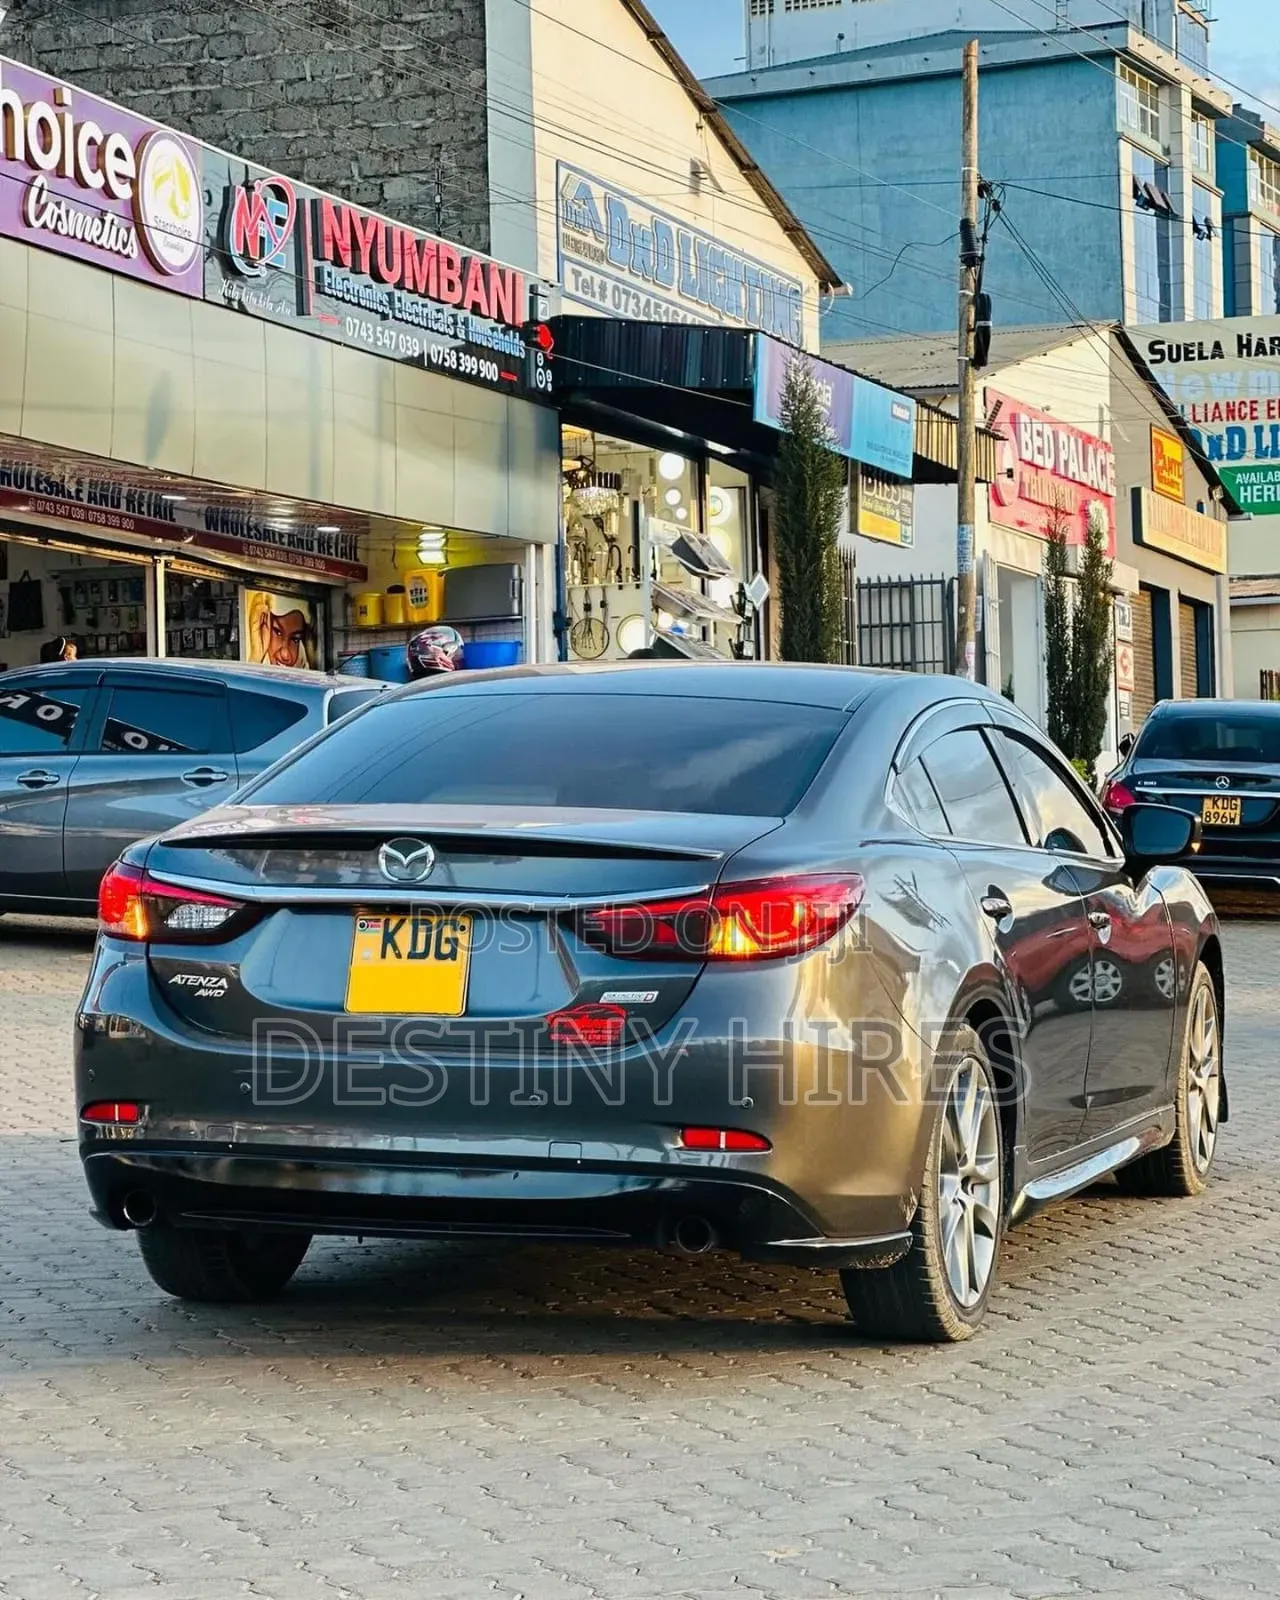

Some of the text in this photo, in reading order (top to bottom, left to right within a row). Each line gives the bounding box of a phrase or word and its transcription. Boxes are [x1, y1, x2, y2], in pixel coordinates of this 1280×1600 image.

[24, 174, 138, 260] Cosmetics
[322, 195, 525, 328] NYUMBANI
[323, 265, 393, 320] Electronics,
[395, 292, 455, 336] Electricals
[468, 314, 526, 359] Households
[345, 315, 499, 382] 0743 547 039 0758 399 900
[1149, 339, 1225, 364] SUELA
[1056, 428, 1116, 498] PALACE
[36, 499, 56, 514] 0743
[55, 504, 70, 517] 547
[1204, 811, 1237, 825] 896W
[1211, 796, 1238, 811] KDG
[381, 917, 460, 961] KDG
[168, 973, 229, 990] ATENZA
[194, 987, 226, 999] AWD
